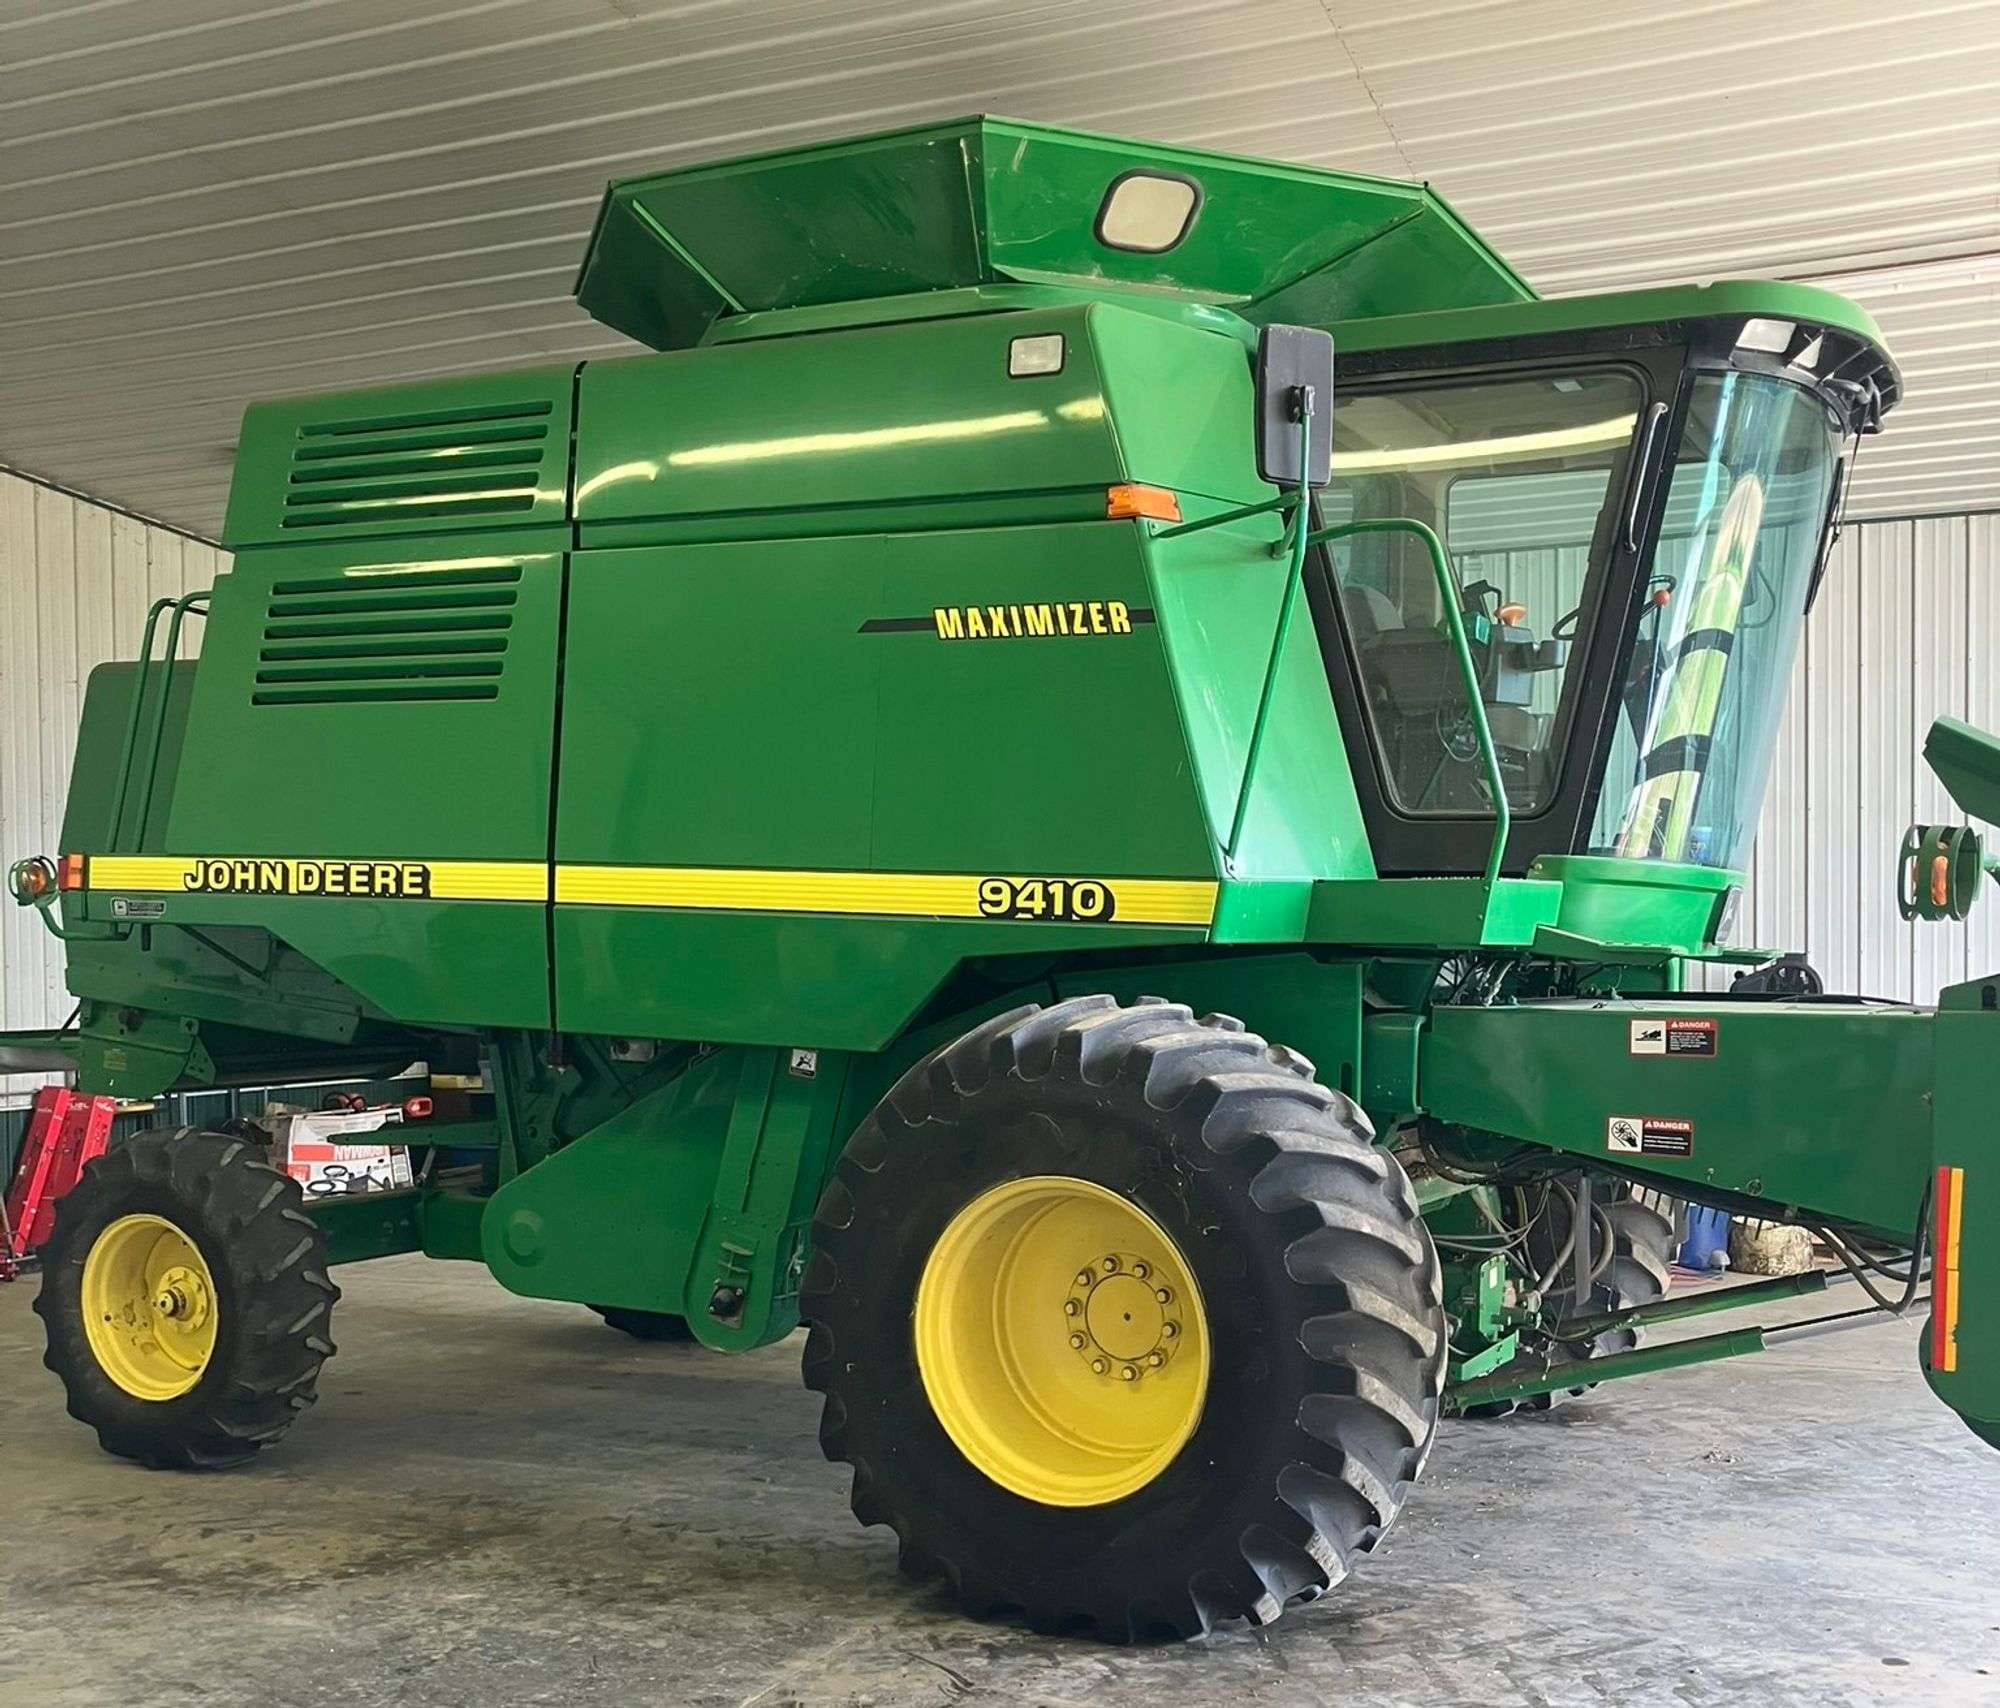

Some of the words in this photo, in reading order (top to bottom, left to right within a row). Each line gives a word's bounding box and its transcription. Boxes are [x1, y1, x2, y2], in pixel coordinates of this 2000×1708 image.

[934, 601, 1132, 640] MAXIMIZER
[185, 860, 286, 891] JOHN
[297, 862, 428, 896] DEERE
[979, 879, 1112, 919] 9410
[1678, 1021, 1711, 1029] DANGER
[1652, 1121, 1690, 1130] DANGER
